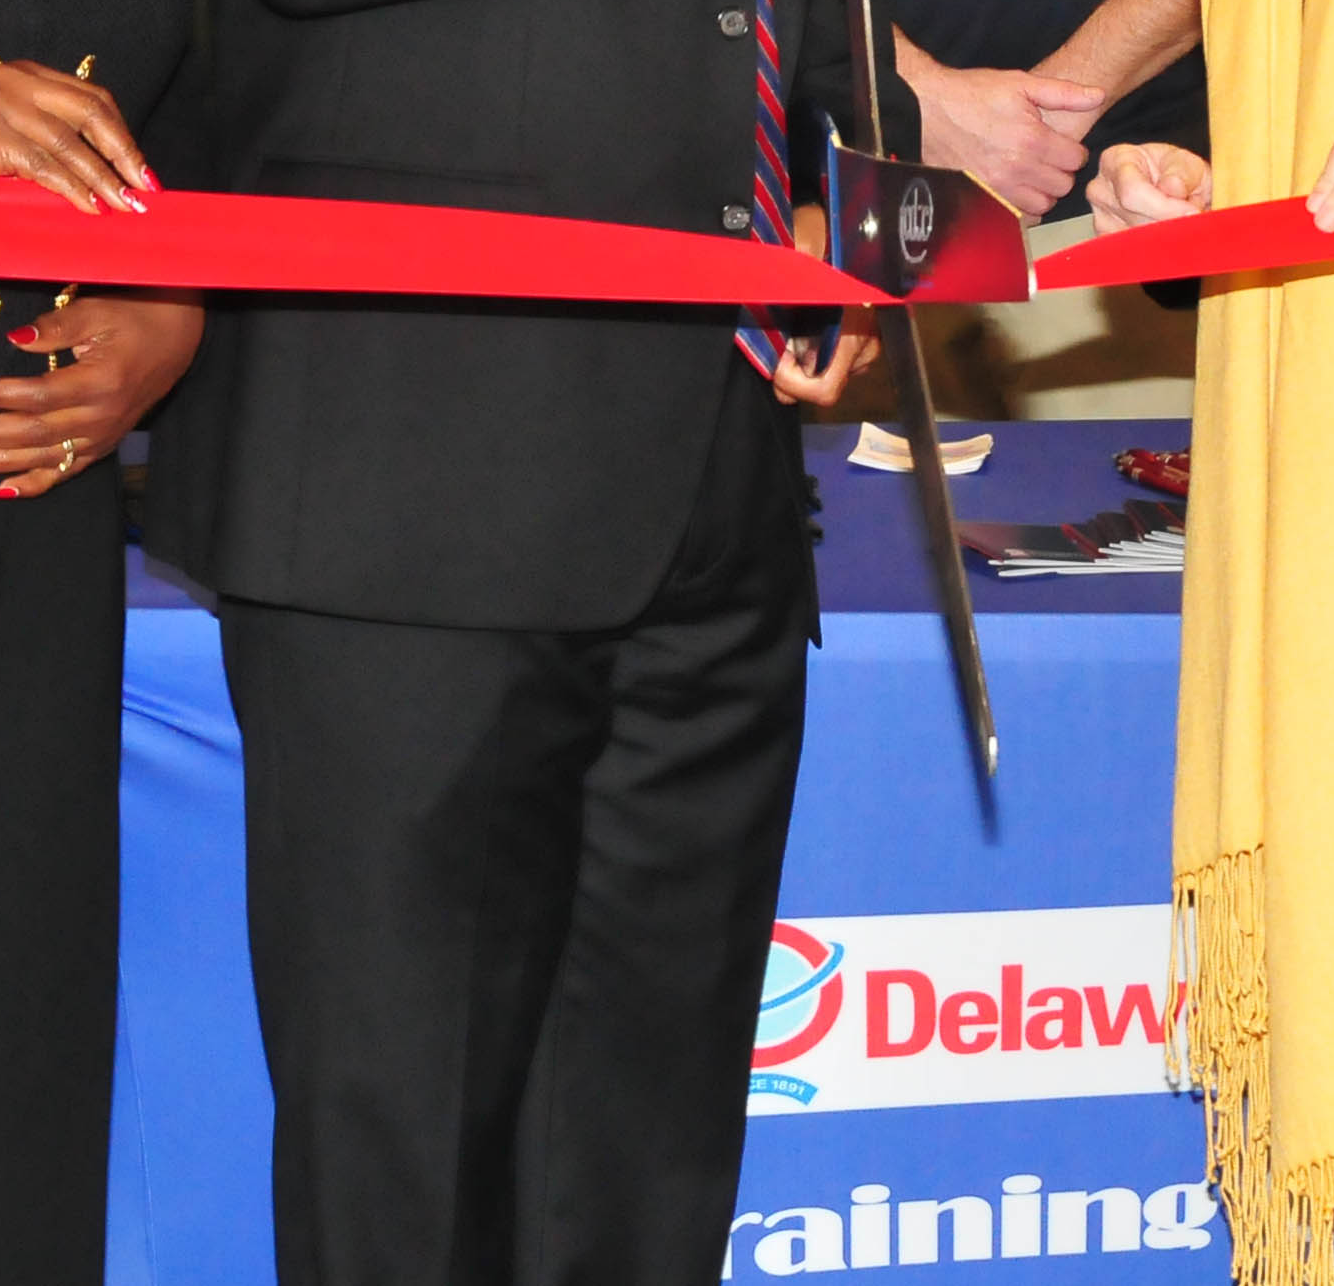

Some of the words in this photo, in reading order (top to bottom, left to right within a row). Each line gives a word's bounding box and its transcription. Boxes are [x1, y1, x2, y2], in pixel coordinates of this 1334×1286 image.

[865, 963, 1188, 1059] Delaw
[771, 1078, 806, 1096] 1891
[721, 1173, 1219, 1281] raining
